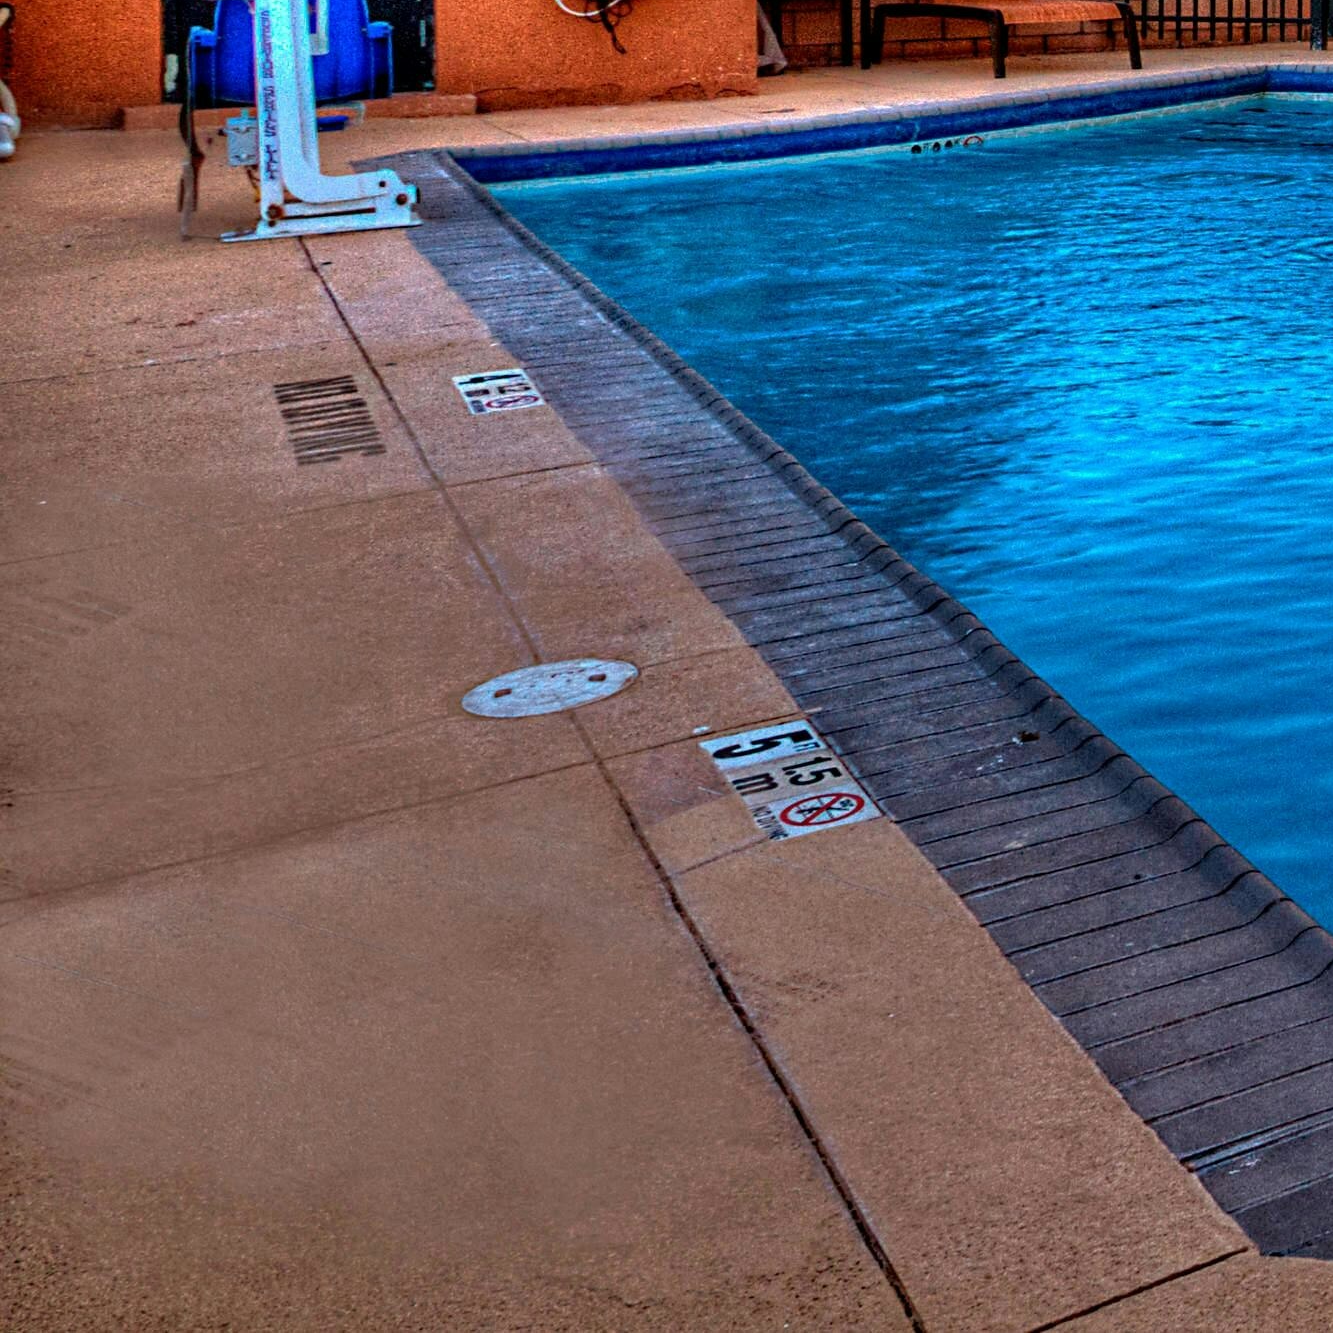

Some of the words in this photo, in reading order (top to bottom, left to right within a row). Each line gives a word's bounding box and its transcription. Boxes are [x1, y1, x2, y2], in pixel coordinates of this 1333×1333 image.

[712, 729, 813, 759] 5
[732, 772, 779, 796] m
[781, 756, 842, 786] 1.5
